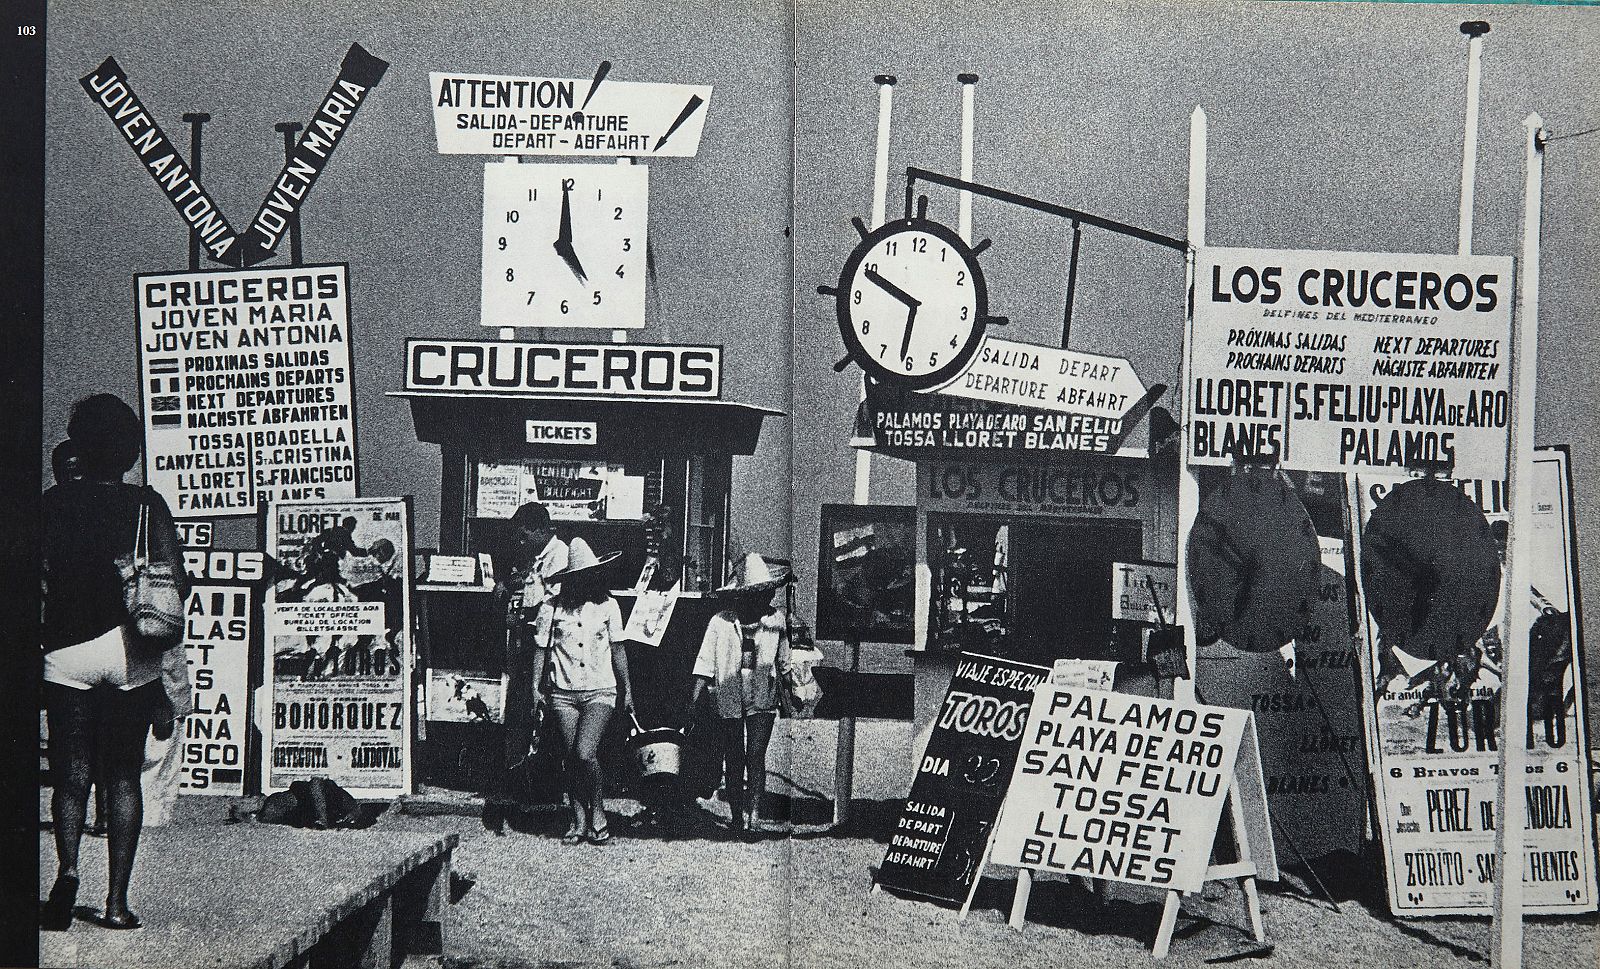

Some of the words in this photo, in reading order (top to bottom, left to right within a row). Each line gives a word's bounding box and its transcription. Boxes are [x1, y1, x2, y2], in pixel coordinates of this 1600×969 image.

[492, 133, 556, 150] DEPART
[574, 134, 650, 151] ABFAHRT
[89, 74, 163, 155] JOVEN
[149, 153, 238, 260] ANTONIA
[253, 156, 318, 250] JOVEN
[302, 78, 366, 159] MARIA
[528, 188, 537, 202] 11
[561, 178, 575, 192] 12
[598, 188, 602, 202] 1
[506, 210, 519, 224] 10
[613, 206, 623, 221] 2
[497, 236, 507, 251] 9
[622, 237, 631, 252] 3
[885, 241, 897, 257] 11
[912, 237, 927, 254] 12
[941, 247, 947, 262] 1
[505, 268, 515, 282] 8
[615, 264, 625, 279] 4
[956, 271, 965, 286] 2
[145, 274, 339, 308] CRUCEROS
[526, 291, 536, 306] 7
[592, 291, 602, 306] 5
[853, 290, 862, 305] 9
[1211, 264, 1282, 305] LOS
[1298, 268, 1499, 313] CRUCEROS
[151, 307, 237, 330] JOVEN
[249, 302, 333, 325] MARIA
[560, 299, 569, 315] 6
[960, 306, 968, 321] 3
[1263, 308, 1319, 321] DELFINES
[1326, 311, 1347, 322] DEL
[1353, 313, 1439, 326] MEDITERRANEO
[145, 329, 229, 353] JOVEN
[237, 323, 343, 348] ANTONIA
[862, 320, 870, 335] 8
[880, 344, 888, 359] 7
[949, 334, 958, 349] 4
[1294, 331, 1347, 353] SALIDAS
[1373, 335, 1413, 355] NEXT
[1414, 337, 1500, 359] DEPARTURES
[184, 353, 259, 373] PROXIMAS
[264, 349, 329, 368] SALIDAS
[411, 343, 714, 393] CRUCEROS
[905, 356, 913, 371] 6
[929, 352, 938, 367] 5
[982, 347, 1040, 371] SALIDA
[1058, 358, 1121, 384] DEPART
[1225, 351, 1291, 372] PROCHAINS
[1293, 354, 1347, 375] DEPARTS
[1427, 361, 1500, 380] ABFAHRTEN
[185, 371, 270, 392] PROCHAINS
[276, 367, 345, 387] DEPARTS
[186, 392, 226, 410] NEXT
[235, 386, 335, 408] DEPARTURES
[965, 371, 1049, 401] DEPARTURE
[1056, 386, 1129, 412] ABFAHRT
[1195, 377, 1284, 419] LLORET
[187, 409, 257, 429] NACHSTE
[262, 403, 349, 424] ABFAHRTEN
[876, 412, 942, 430] PALAMOS
[1033, 415, 1067, 433] SAN
[1070, 416, 1123, 435] FELIU
[187, 432, 245, 451] TOSSA
[254, 427, 346, 447] BOADELLA
[531, 425, 592, 441] TICKETS
[885, 431, 936, 447] TOSSA
[942, 430, 1018, 448] LLORET
[1024, 432, 1110, 452] BLANES
[1193, 420, 1282, 460] BLANES
[1339, 427, 1455, 469] PALAMOS
[155, 451, 245, 472] CANYELLAS
[177, 471, 245, 491] LLORET
[928, 464, 983, 500] LOS
[998, 467, 1140, 508] CRUCEROS
[178, 490, 248, 510] FANALS
[279, 513, 342, 535] LLORET
[182, 551, 264, 580] ROS
[955, 660, 994, 684] VIAJE
[274, 702, 403, 730] BOHORQUEZ
[938, 692, 1031, 741] TOROS
[1048, 691, 1226, 738] PALAMOS
[1034, 720, 1118, 755] PLAYA
[1126, 733, 1160, 761] DE
[1165, 741, 1224, 769] ARO
[351, 746, 401, 769] SANDOVAL
[921, 755, 950, 778] DIA
[1022, 750, 1104, 783] SAN
[1115, 761, 1221, 798] FELIU
[1389, 767, 1403, 778] 6
[1413, 761, 1480, 778] Bravos
[1556, 761, 1569, 773] 6
[905, 800, 946, 818] SALIDA
[1053, 782, 1171, 824] TOSSA
[1426, 787, 1473, 832] PEREZ
[898, 817, 943, 835] DEPART
[1034, 811, 1182, 854] LLORET
[892, 834, 943, 855] DEPARTURE
[884, 851, 935, 871] ABFAHRT
[1019, 839, 1177, 884] BLANES
[1405, 852, 1465, 887] ZURITO
[1530, 850, 1579, 882] FUENTES
